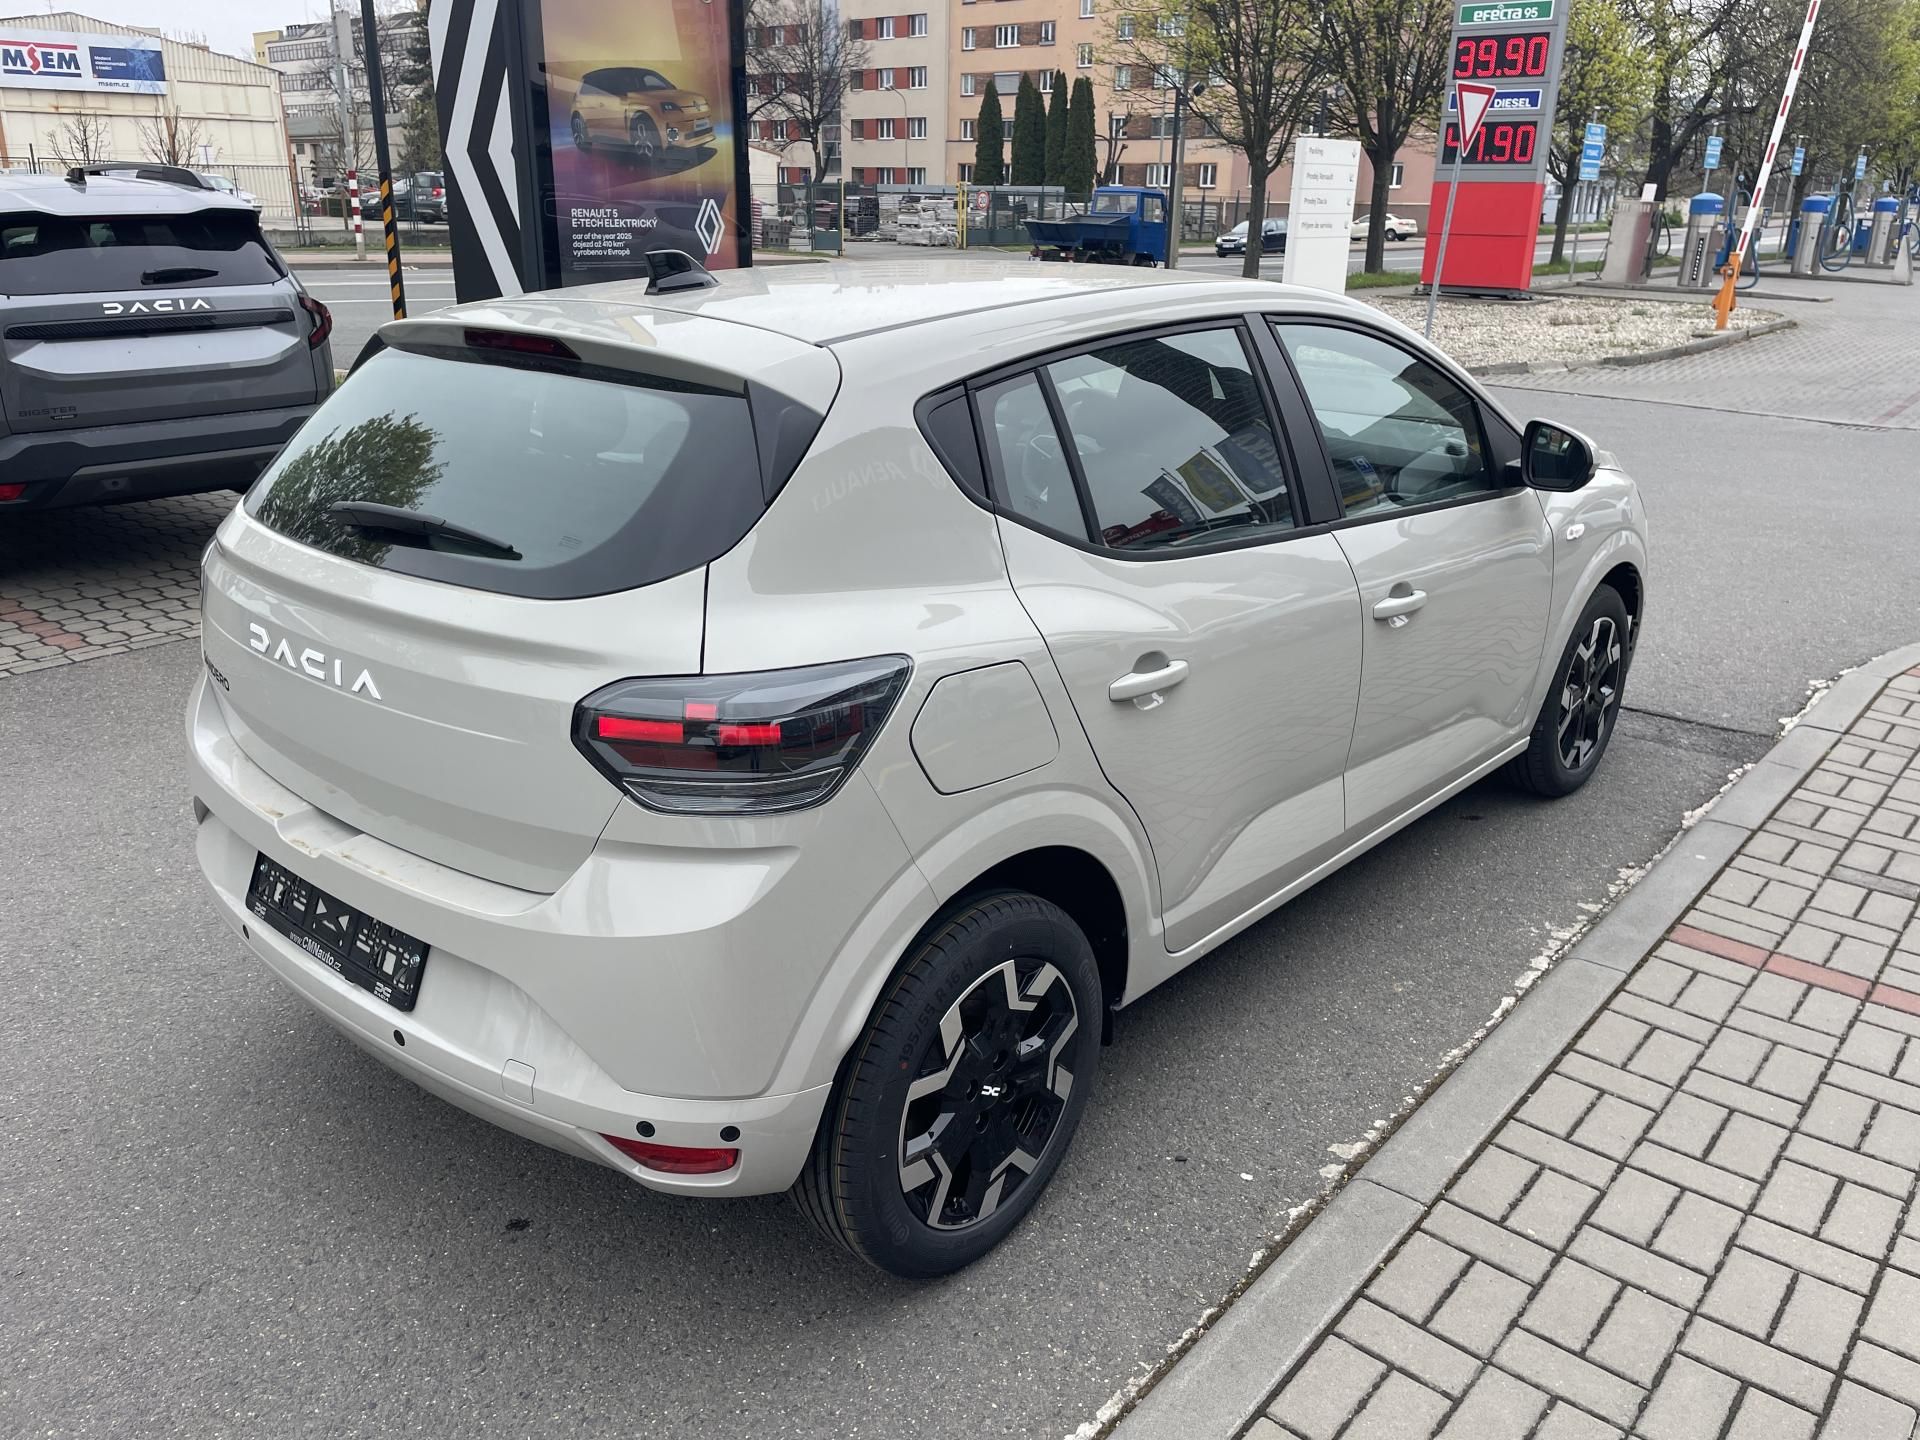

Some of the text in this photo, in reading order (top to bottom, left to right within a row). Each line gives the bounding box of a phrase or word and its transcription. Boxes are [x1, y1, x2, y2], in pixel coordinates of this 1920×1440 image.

[1524, 8, 1538, 18] 95
[2, 46, 81, 71] MSEM
[1454, 36, 1549, 78] 39.90
[1493, 98, 1531, 108] DIESEL
[571, 208, 618, 217] RENAULT 5
[572, 217, 658, 228] E-TECH ELEKTRICKÝ
[602, 233, 615, 241] year
[573, 240, 594, 249] dojezd
[573, 248, 602, 257] vyrobeno
[608, 248, 631, 256] Evropě
[102, 298, 211, 314] DACIA
[18, 406, 78, 418] BIGSTER
[249, 622, 382, 701] DACIA
[934, 988, 947, 1003] R
[945, 968, 961, 990] 16
